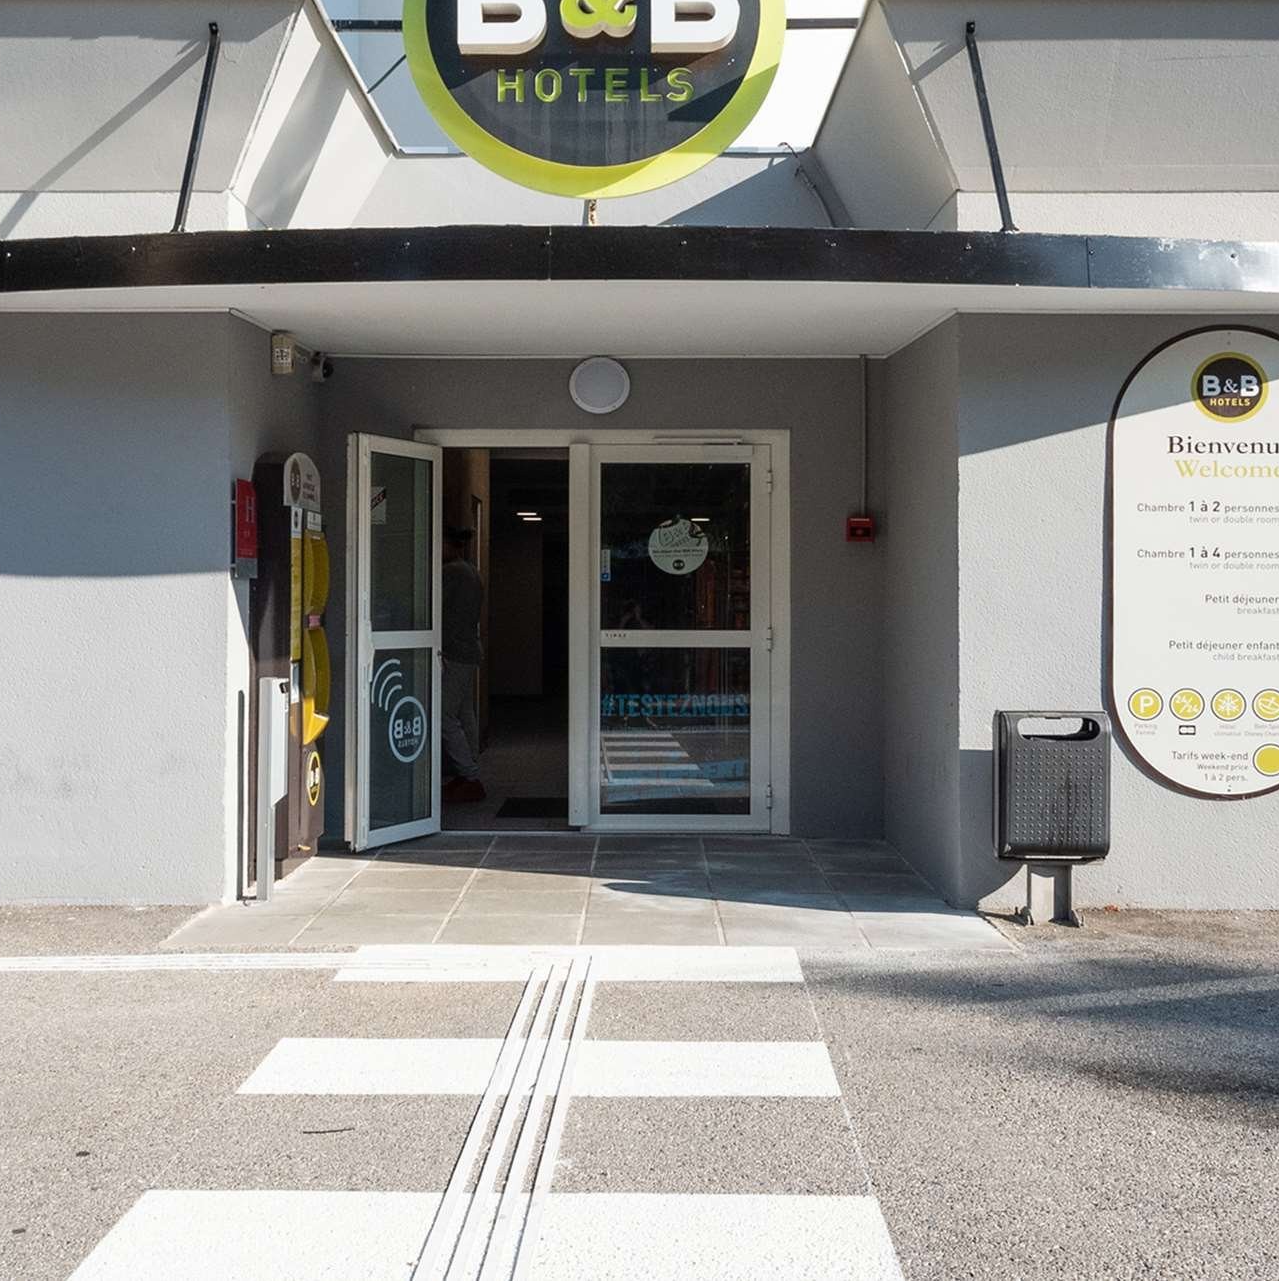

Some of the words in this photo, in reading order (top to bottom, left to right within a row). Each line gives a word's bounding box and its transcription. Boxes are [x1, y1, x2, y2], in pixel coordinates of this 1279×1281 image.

[496, 68, 695, 103] HOTELS
[1202, 374, 1260, 397] B&B
[1209, 398, 1251, 407] HOTELS
[1136, 503, 1186, 512] Chambre
[1189, 501, 1195, 512] 1
[1200, 500, 1208, 512] à
[1212, 501, 1221, 512] 2
[1136, 549, 1186, 559] Chambre
[1189, 547, 1195, 559] 1
[1200, 546, 1208, 559] à
[1212, 547, 1221, 559] 4
[1205, 594, 1230, 604] Petit
[1232, 594, 1279, 606] déjeuner
[1237, 607, 1279, 615] breakfast
[1169, 640, 1193, 650] Petit
[1196, 640, 1243, 652] déjeuner
[1246, 640, 1279, 650] enfant
[1237, 653, 1279, 661] breakfast
[601, 694, 750, 718] #TESTEZNOUS
[1172, 751, 1199, 760] Tarifs
[1201, 752, 1249, 760] week-end
